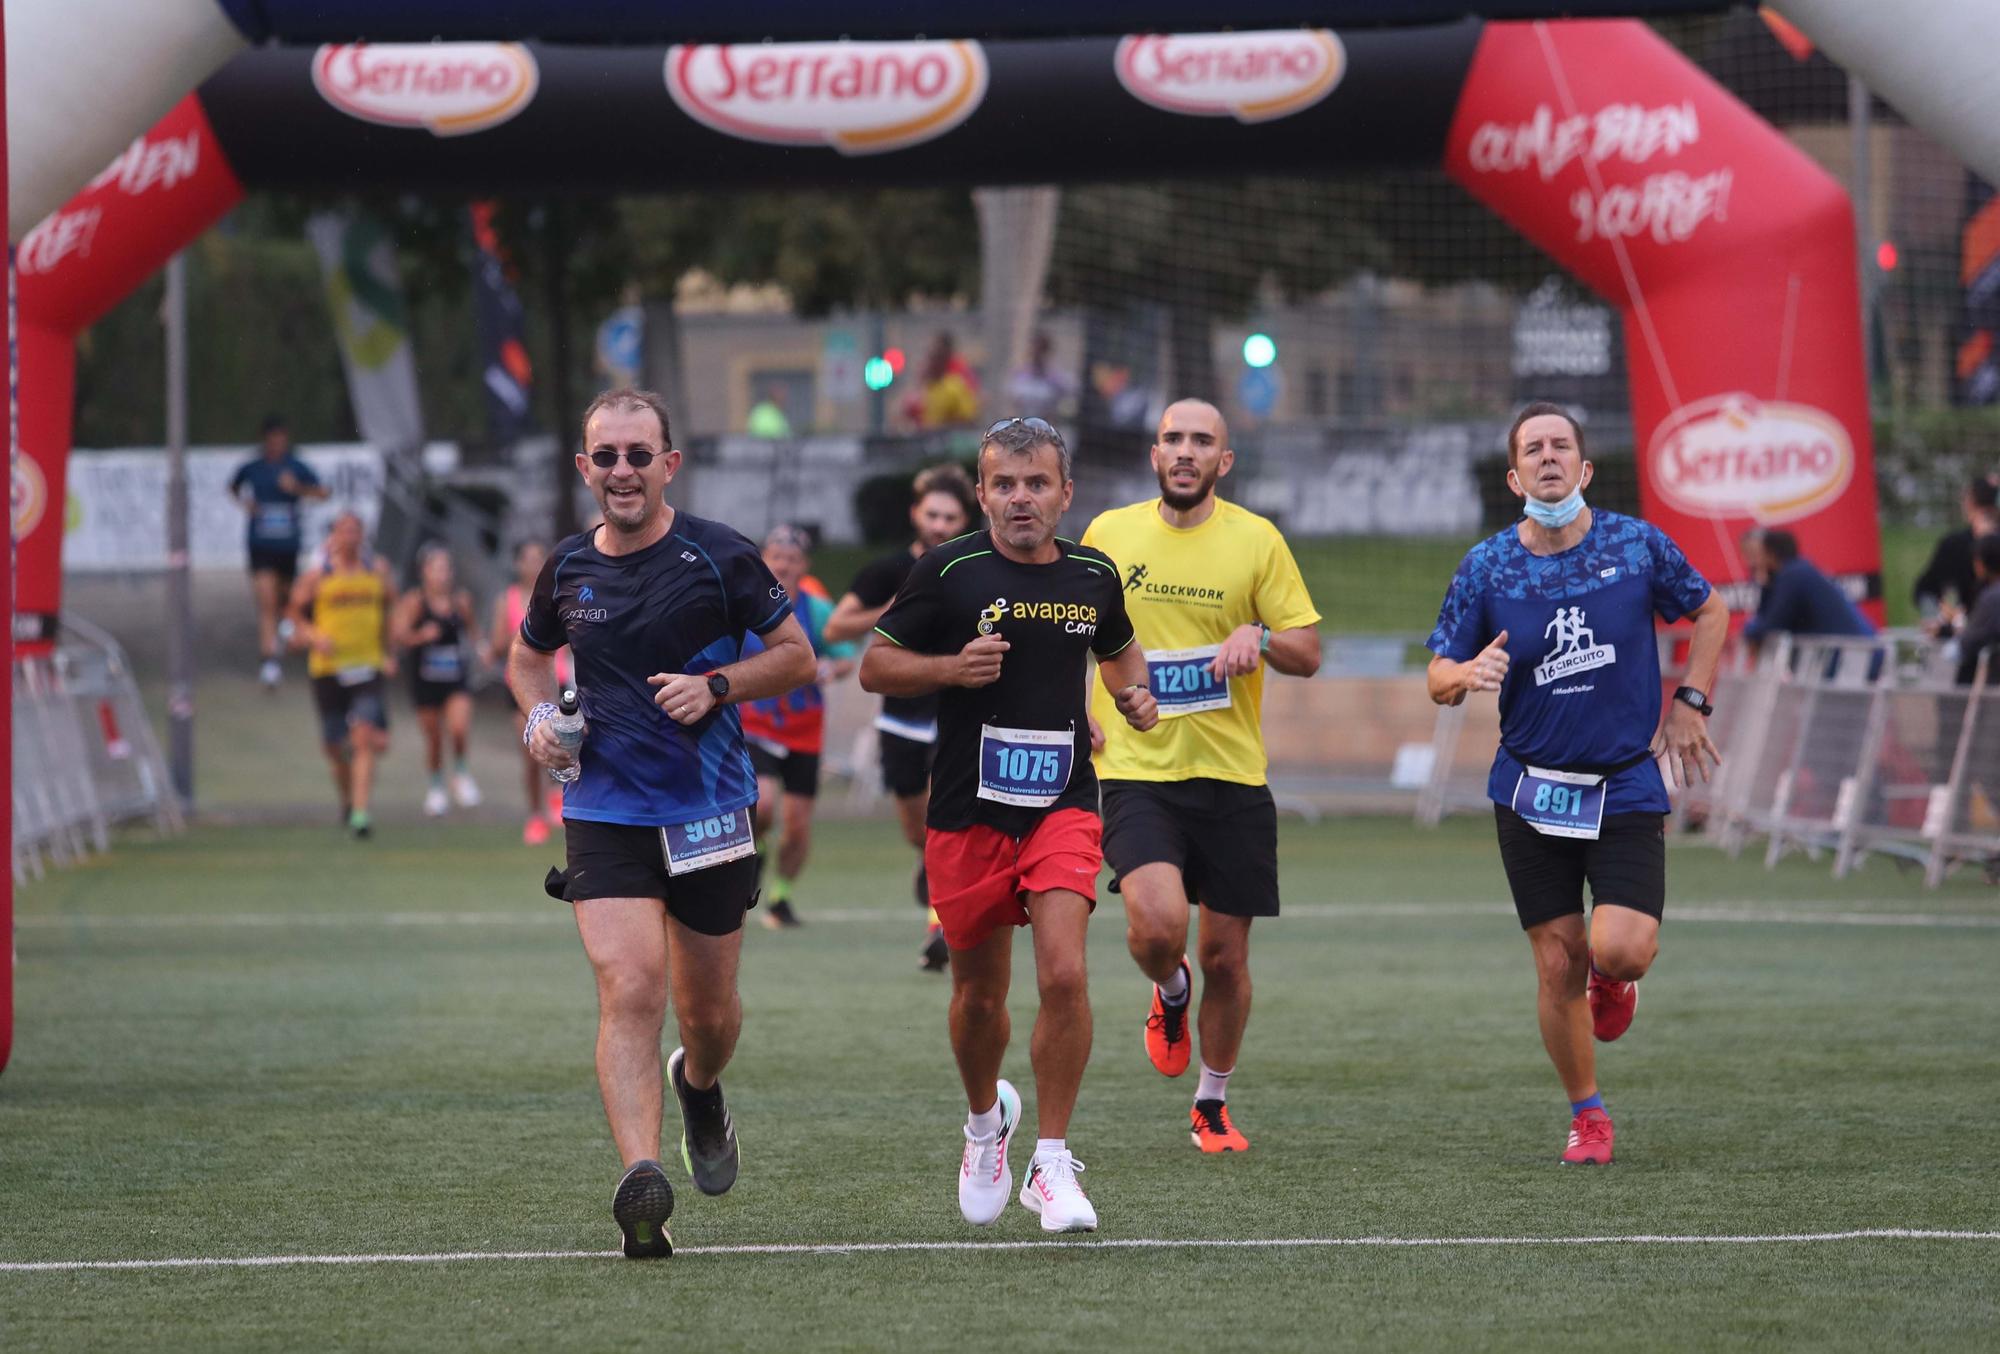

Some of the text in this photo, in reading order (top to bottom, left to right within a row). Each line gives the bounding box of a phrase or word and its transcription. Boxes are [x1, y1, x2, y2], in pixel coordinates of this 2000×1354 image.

[342, 44, 511, 96] Serrano
[706, 44, 949, 101] Serrano
[1148, 36, 1318, 84] Serrano
[1668, 426, 1834, 488] Serrano
[1145, 583, 1225, 601] CLOCKWORK
[1013, 602, 1097, 625] avapace
[1154, 662, 1214, 693] 1201
[1541, 664, 1557, 681] 16
[1556, 649, 1606, 671] CIRCUITO
[996, 747, 1059, 783] 1075
[1009, 786, 1040, 795] Universitat
[1533, 783, 1583, 817] 891
[680, 848, 702, 859] Carrera
[702, 841, 729, 853] Universitat
